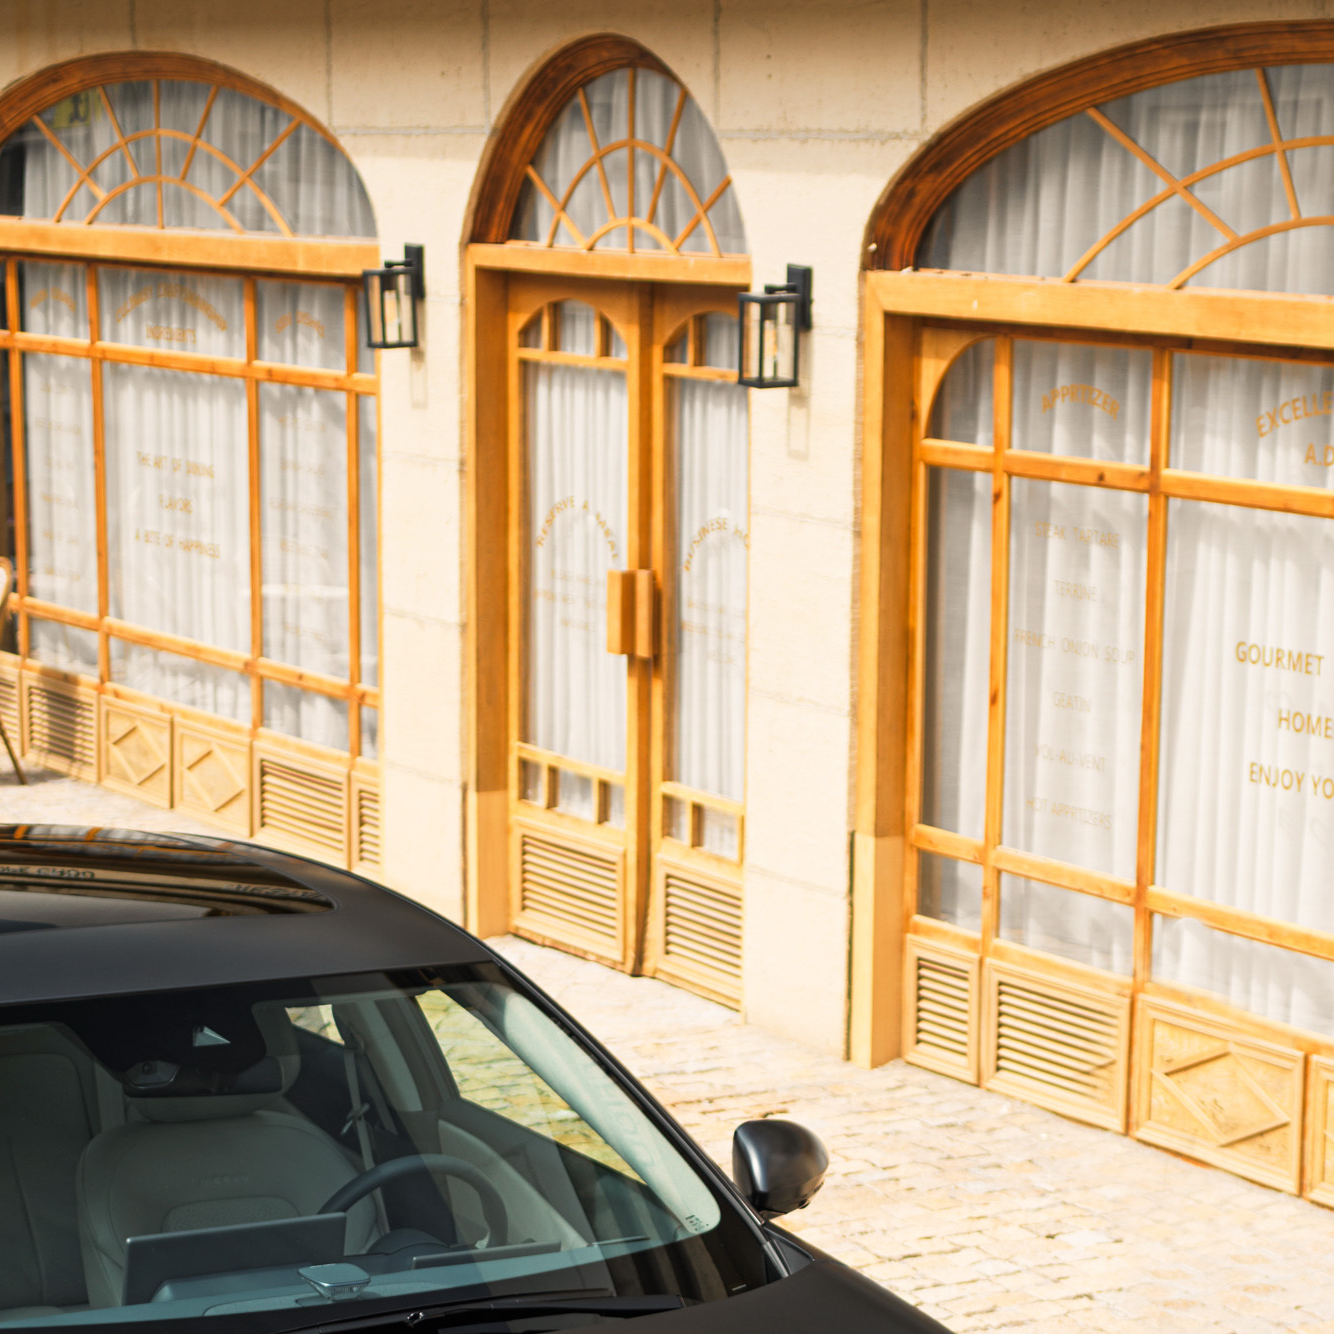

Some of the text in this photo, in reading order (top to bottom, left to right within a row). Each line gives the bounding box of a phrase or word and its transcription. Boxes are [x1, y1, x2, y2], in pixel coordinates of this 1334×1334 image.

[1035, 521, 1120, 550] STEAK TARTARE
[1055, 580, 1098, 601] TERRINE
[1013, 628, 1135, 665] FRENCH ONION SOUP
[1235, 641, 1324, 676] GOURMET
[1249, 762, 1304, 793] ENJOY
